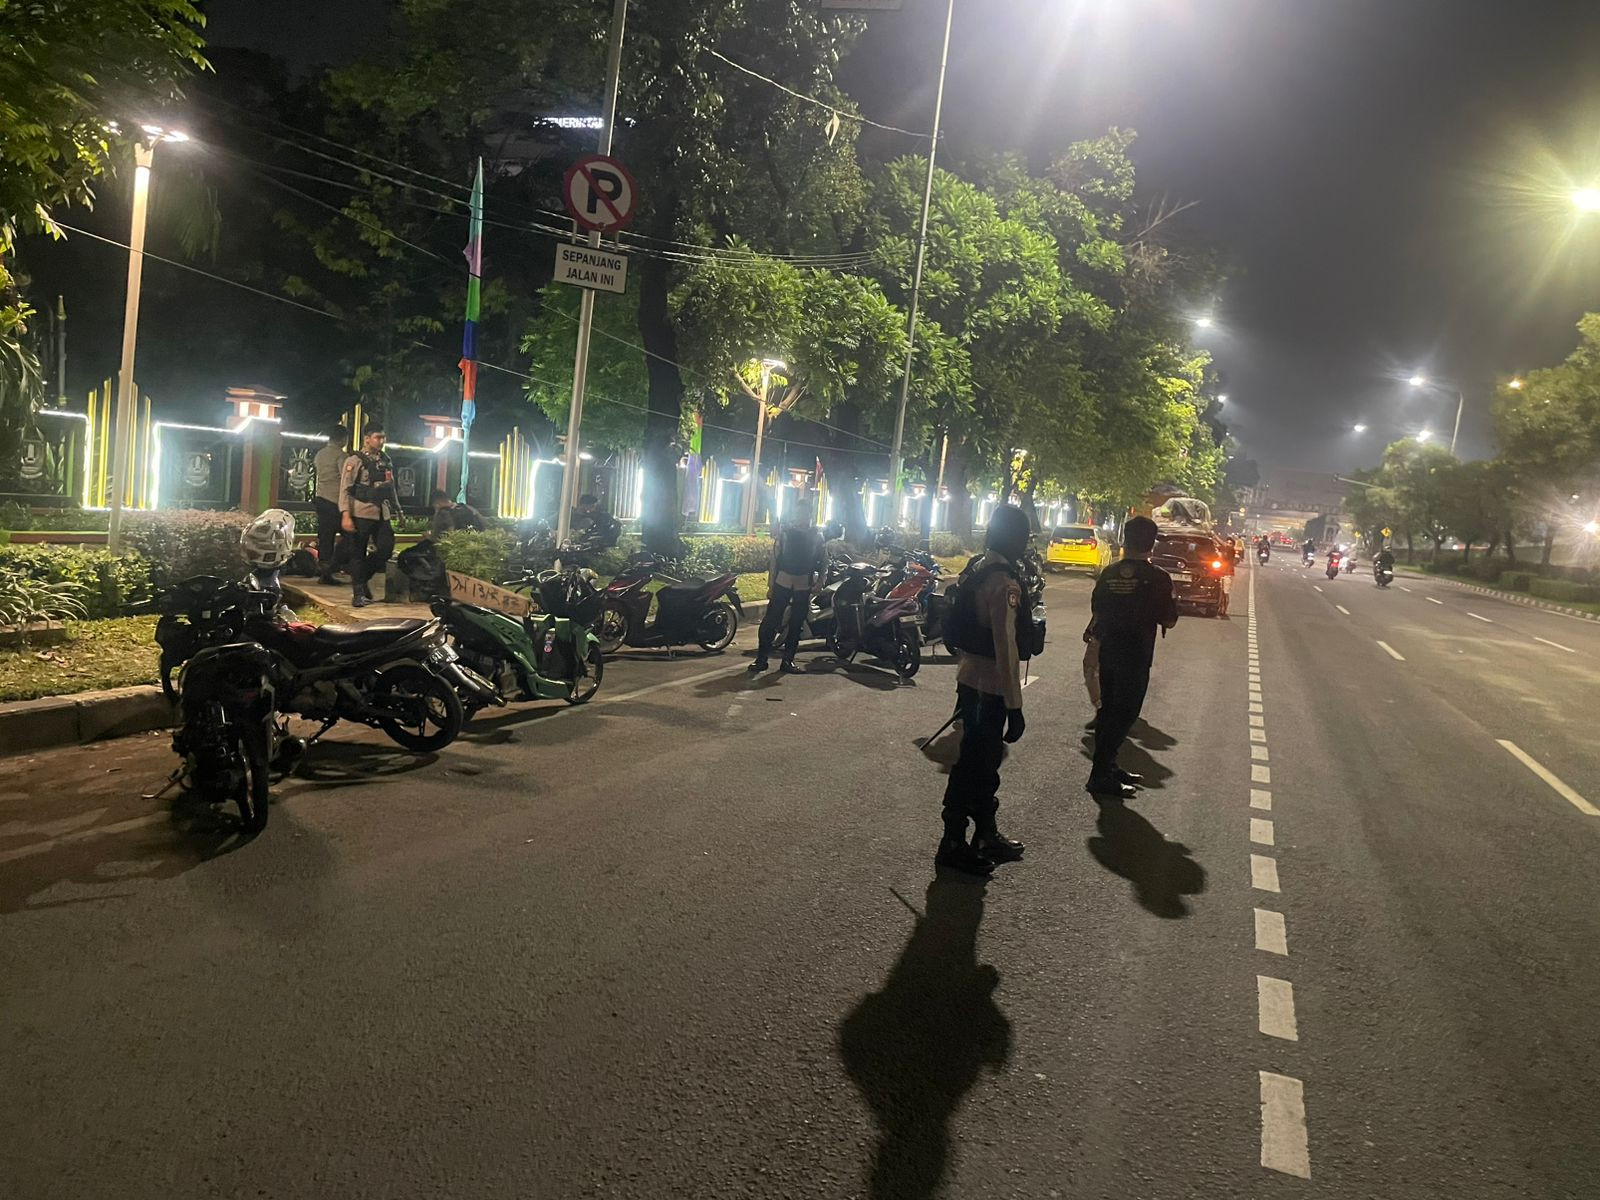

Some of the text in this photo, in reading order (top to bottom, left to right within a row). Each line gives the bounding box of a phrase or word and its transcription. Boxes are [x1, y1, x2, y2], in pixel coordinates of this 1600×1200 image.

[587, 168, 622, 214] P
[562, 249, 622, 271] SEPANJANG
[566, 267, 615, 287] JALAN INI
